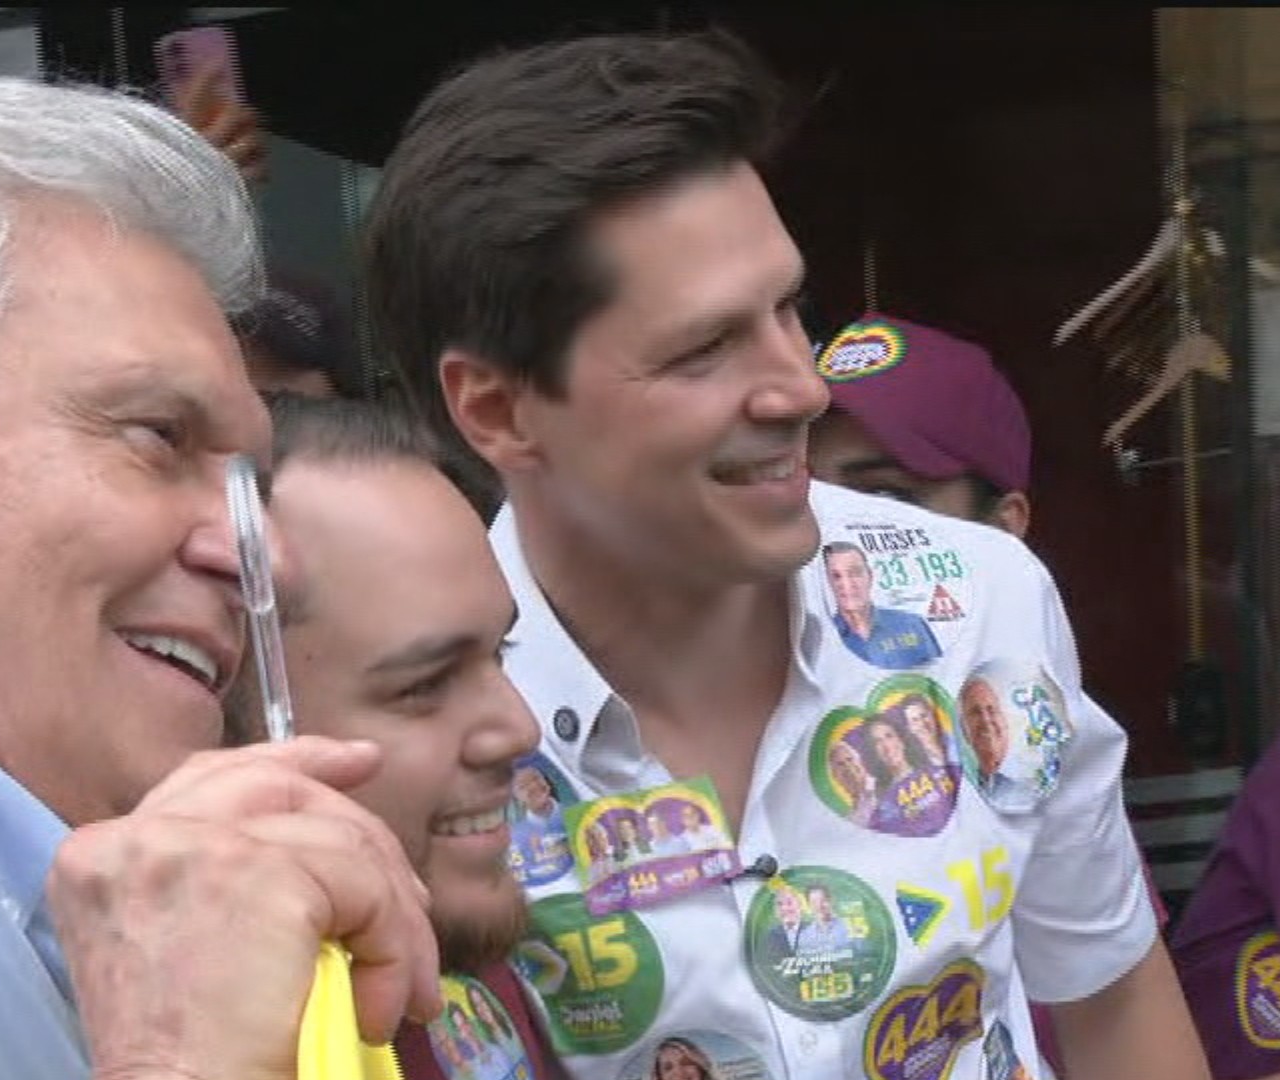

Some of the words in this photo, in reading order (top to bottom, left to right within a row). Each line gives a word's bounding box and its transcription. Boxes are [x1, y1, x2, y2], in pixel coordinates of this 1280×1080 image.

[916, 550, 964, 582] 193
[945, 845, 1015, 931] 15
[555, 920, 638, 991] 15
[877, 981, 977, 1067] 444
